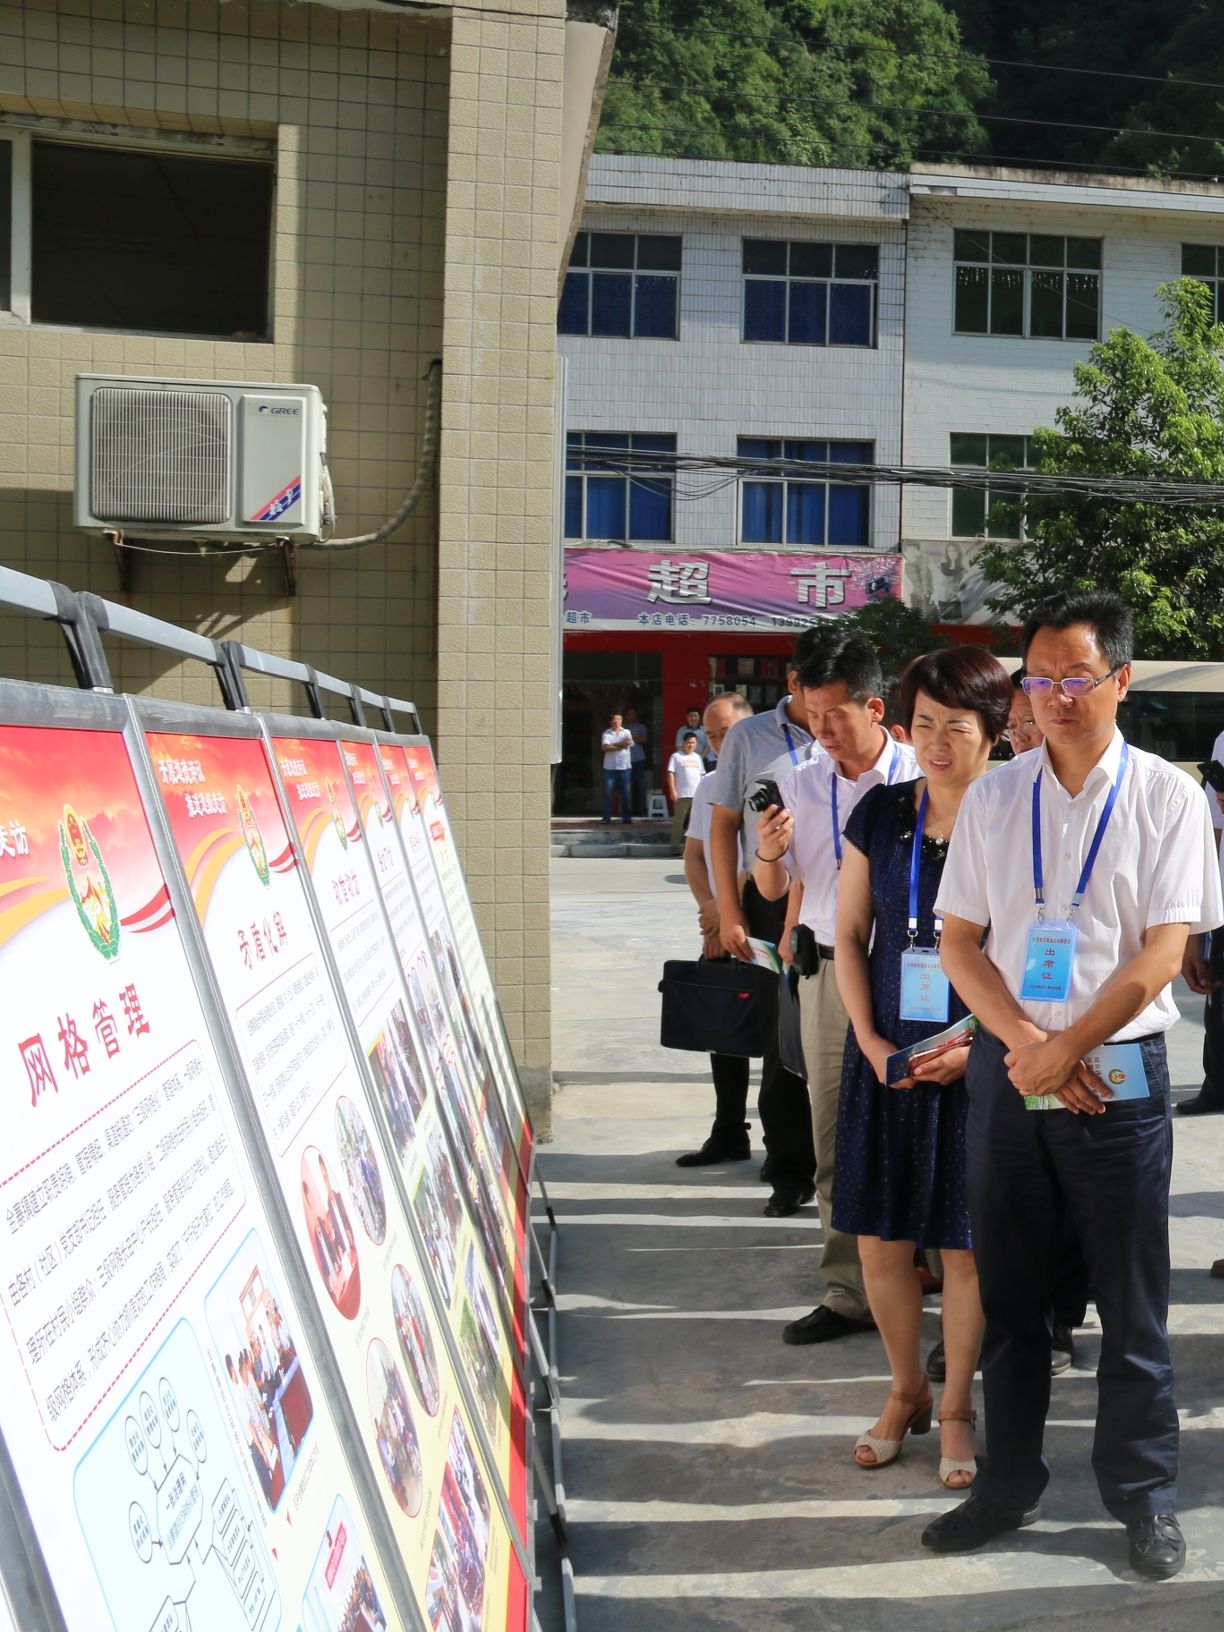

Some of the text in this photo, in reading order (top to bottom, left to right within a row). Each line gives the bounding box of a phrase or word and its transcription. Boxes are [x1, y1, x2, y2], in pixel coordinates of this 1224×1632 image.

[271, 407, 300, 415] GREE
[563, 559, 852, 608] 超市
[17, 983, 152, 1108] 网格管理
